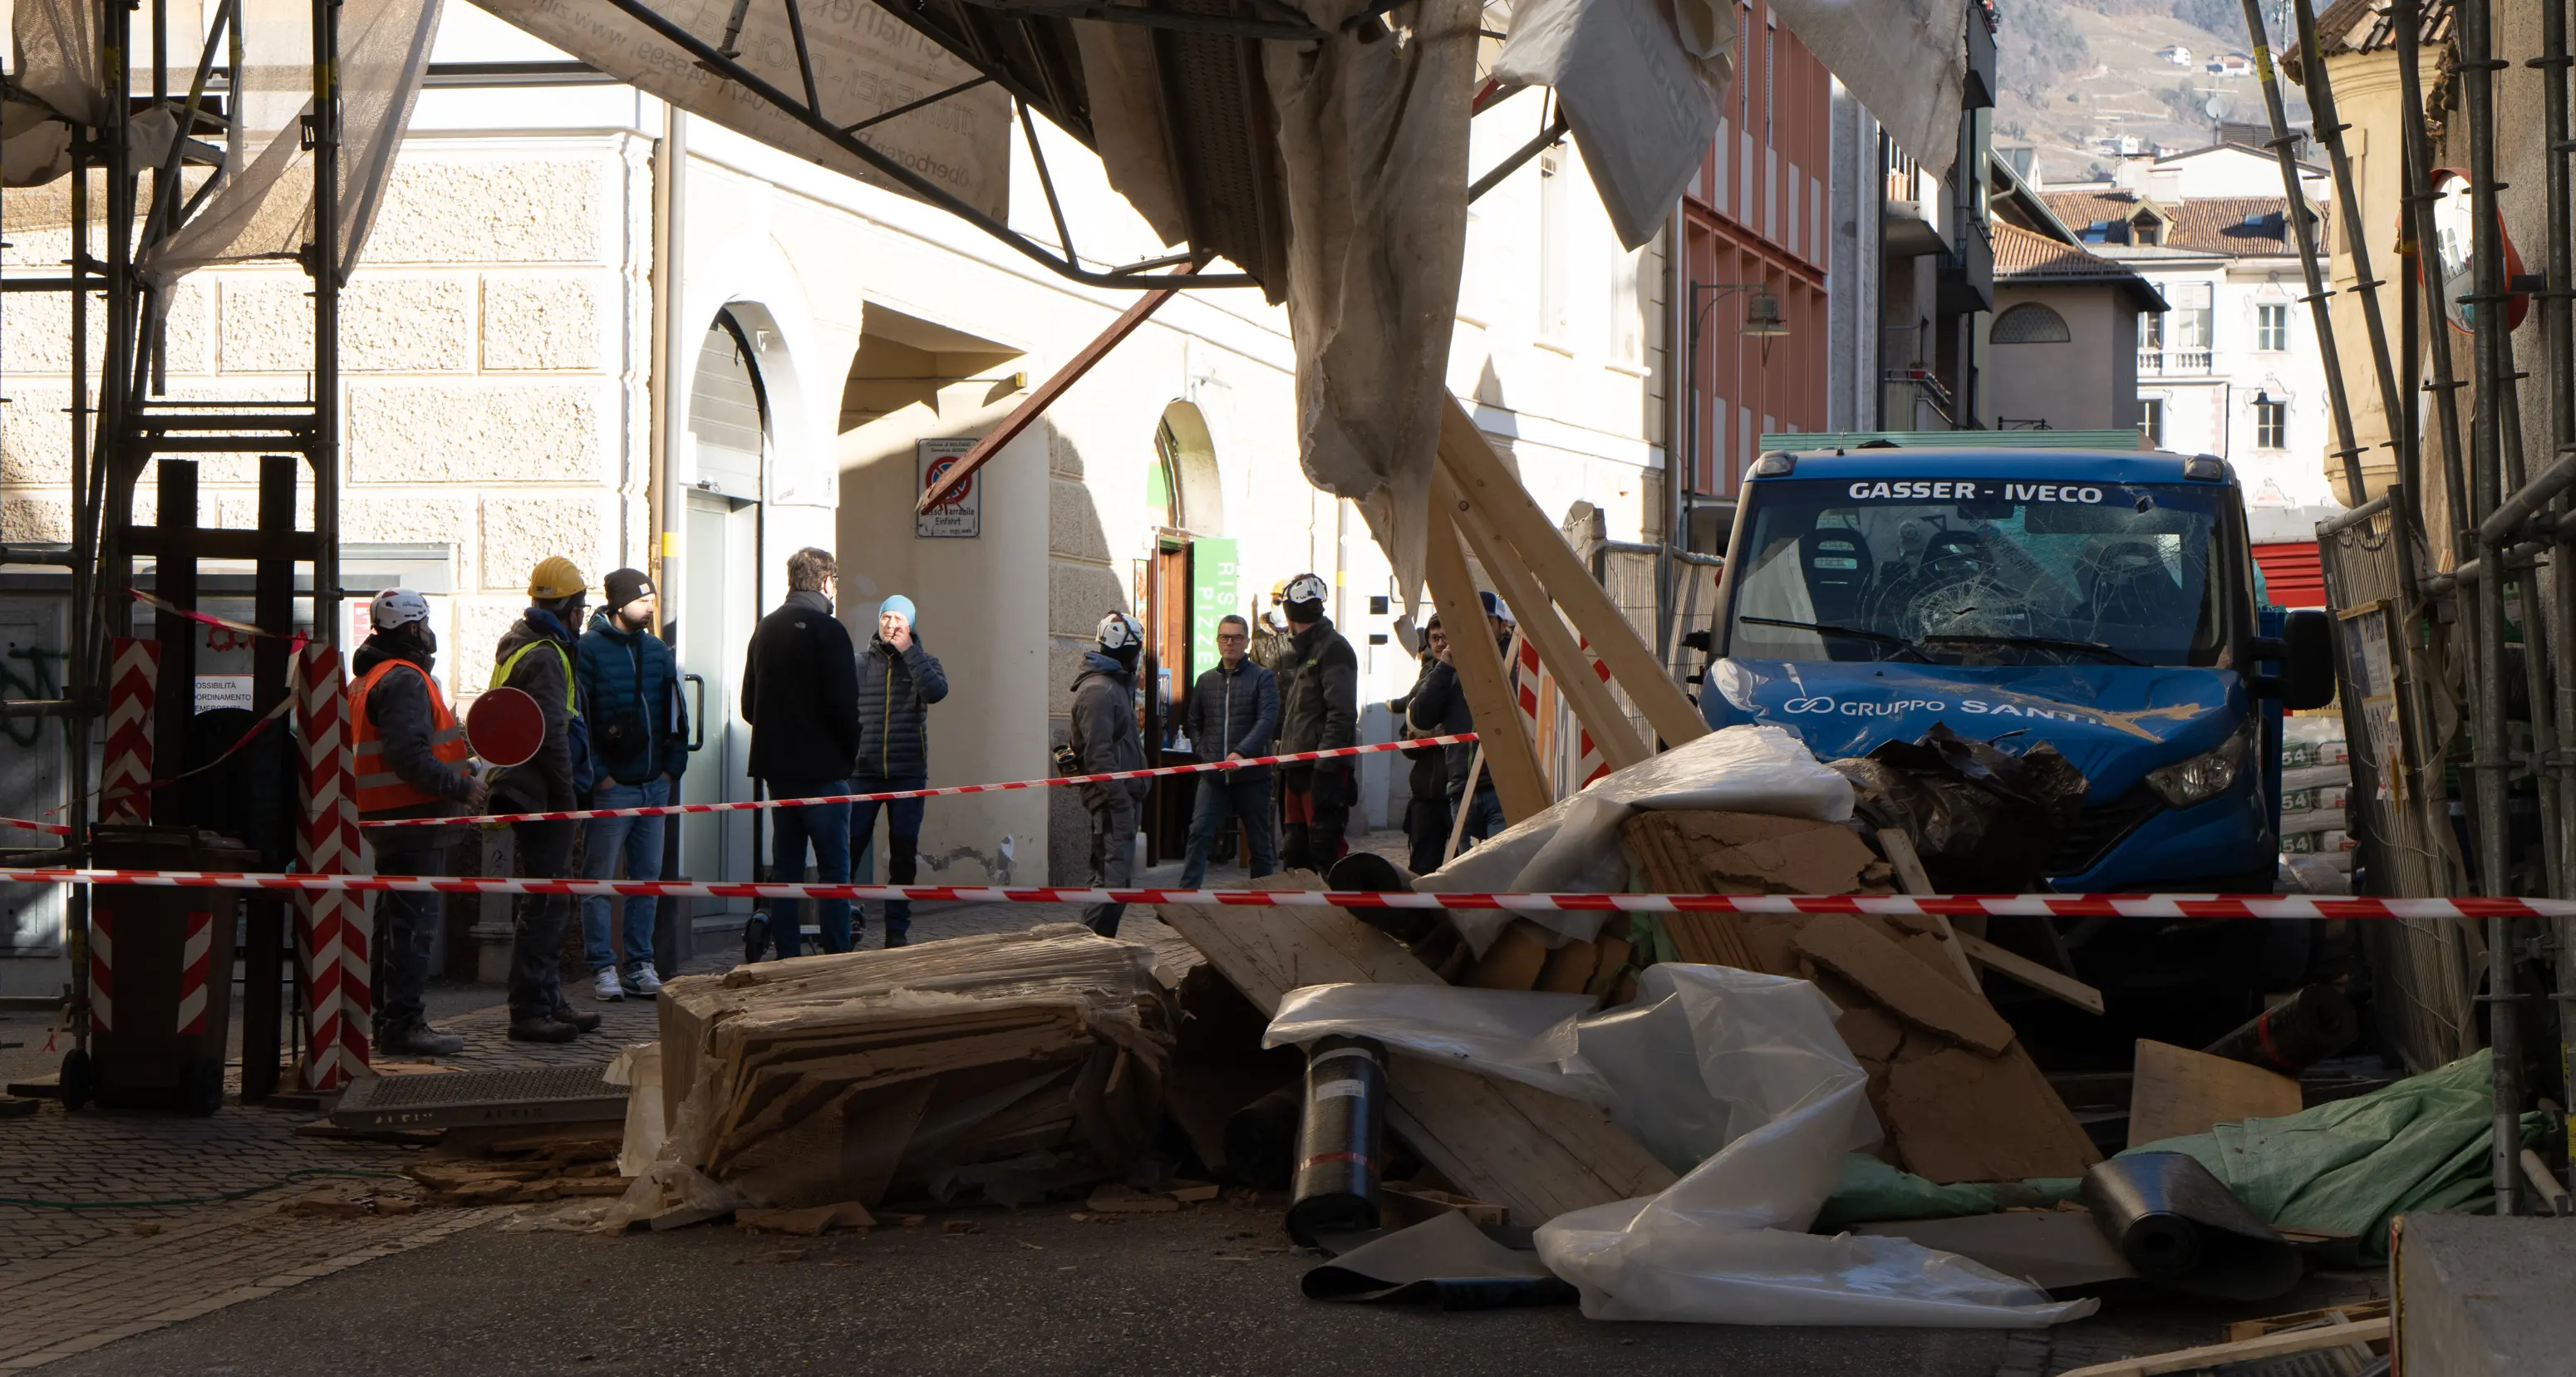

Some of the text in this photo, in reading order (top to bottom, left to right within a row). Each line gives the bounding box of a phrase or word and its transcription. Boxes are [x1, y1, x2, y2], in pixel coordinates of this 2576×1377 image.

[1849, 482, 1976, 499] GASSER
[2003, 484, 2103, 504] IVECO
[946, 507, 976, 516] arrabile
[935, 517, 961, 526] Einfahrt
[1217, 562, 1235, 617] RIS
[1196, 586, 1215, 674] PIZZE
[194, 681, 237, 690] OSSIBILITÀ
[195, 693, 252, 701] ORDINAMENTO
[1840, 700, 1945, 717] GRUPPO
